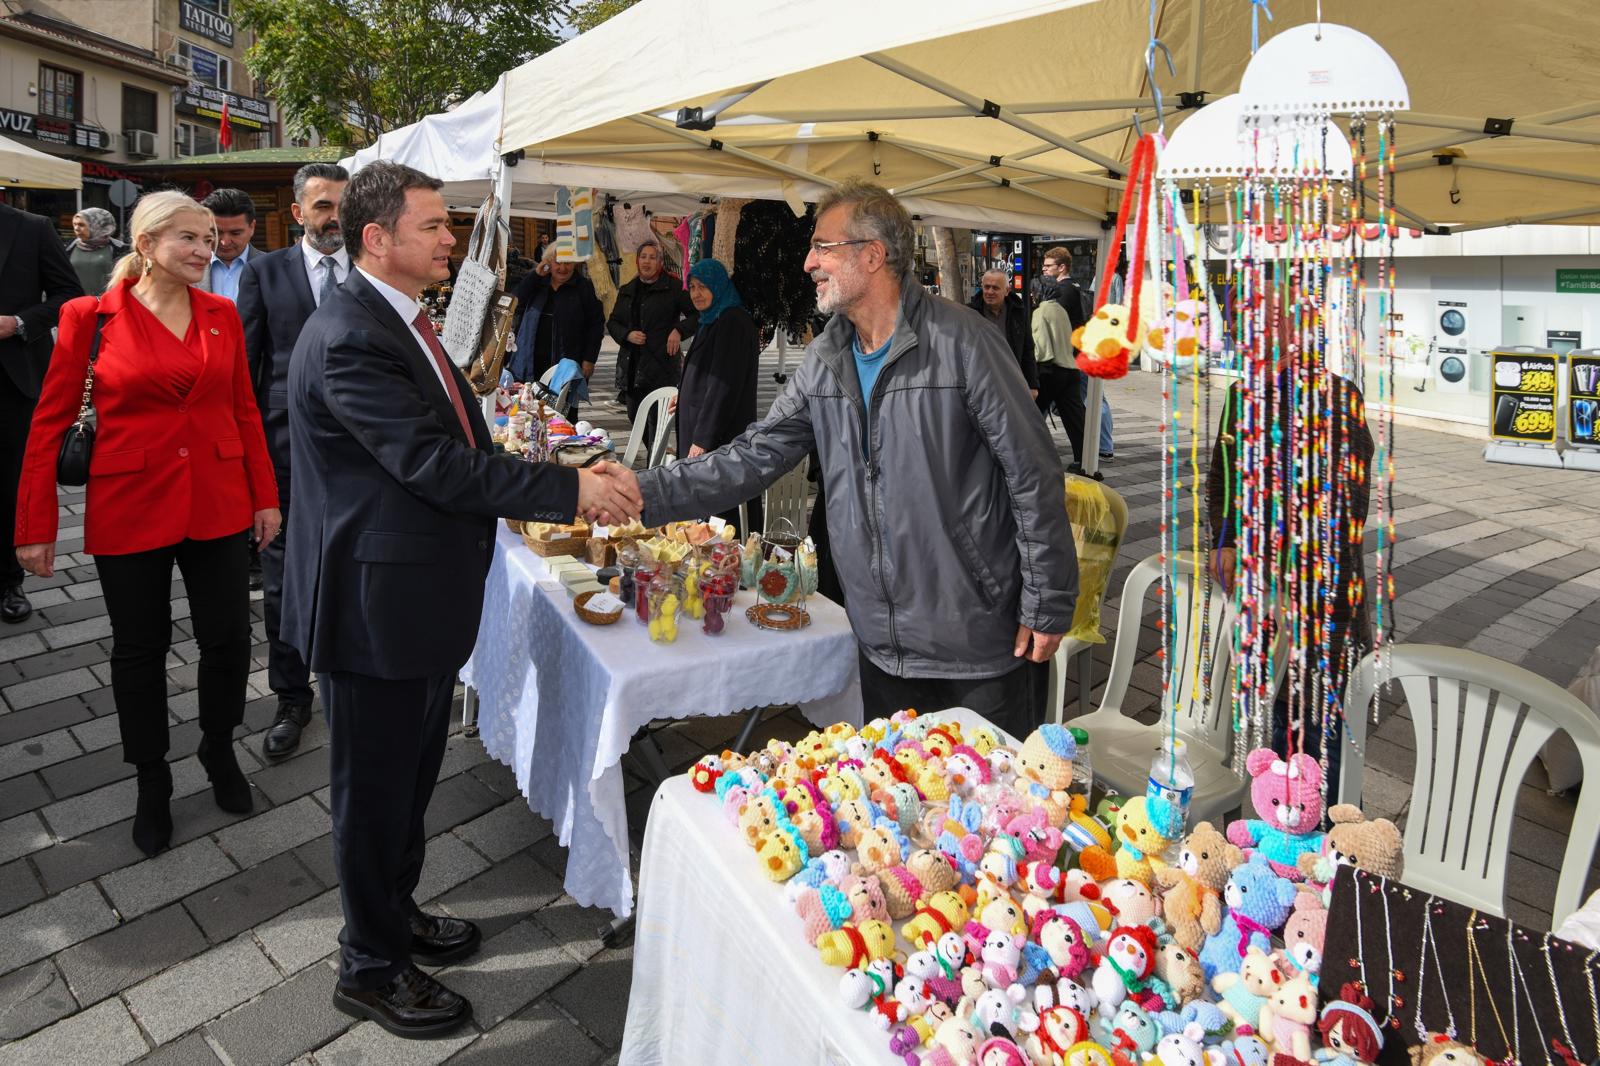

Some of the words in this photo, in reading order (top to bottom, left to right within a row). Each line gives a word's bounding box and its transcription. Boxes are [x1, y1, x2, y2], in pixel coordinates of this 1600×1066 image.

[184, 2, 232, 36] TATTOO
[185, 19, 214, 37] STUDIO
[0, 111, 33, 133] VUZ
[1529, 362, 1554, 370] AirPods
[1520, 402, 1553, 411] Powerbank
